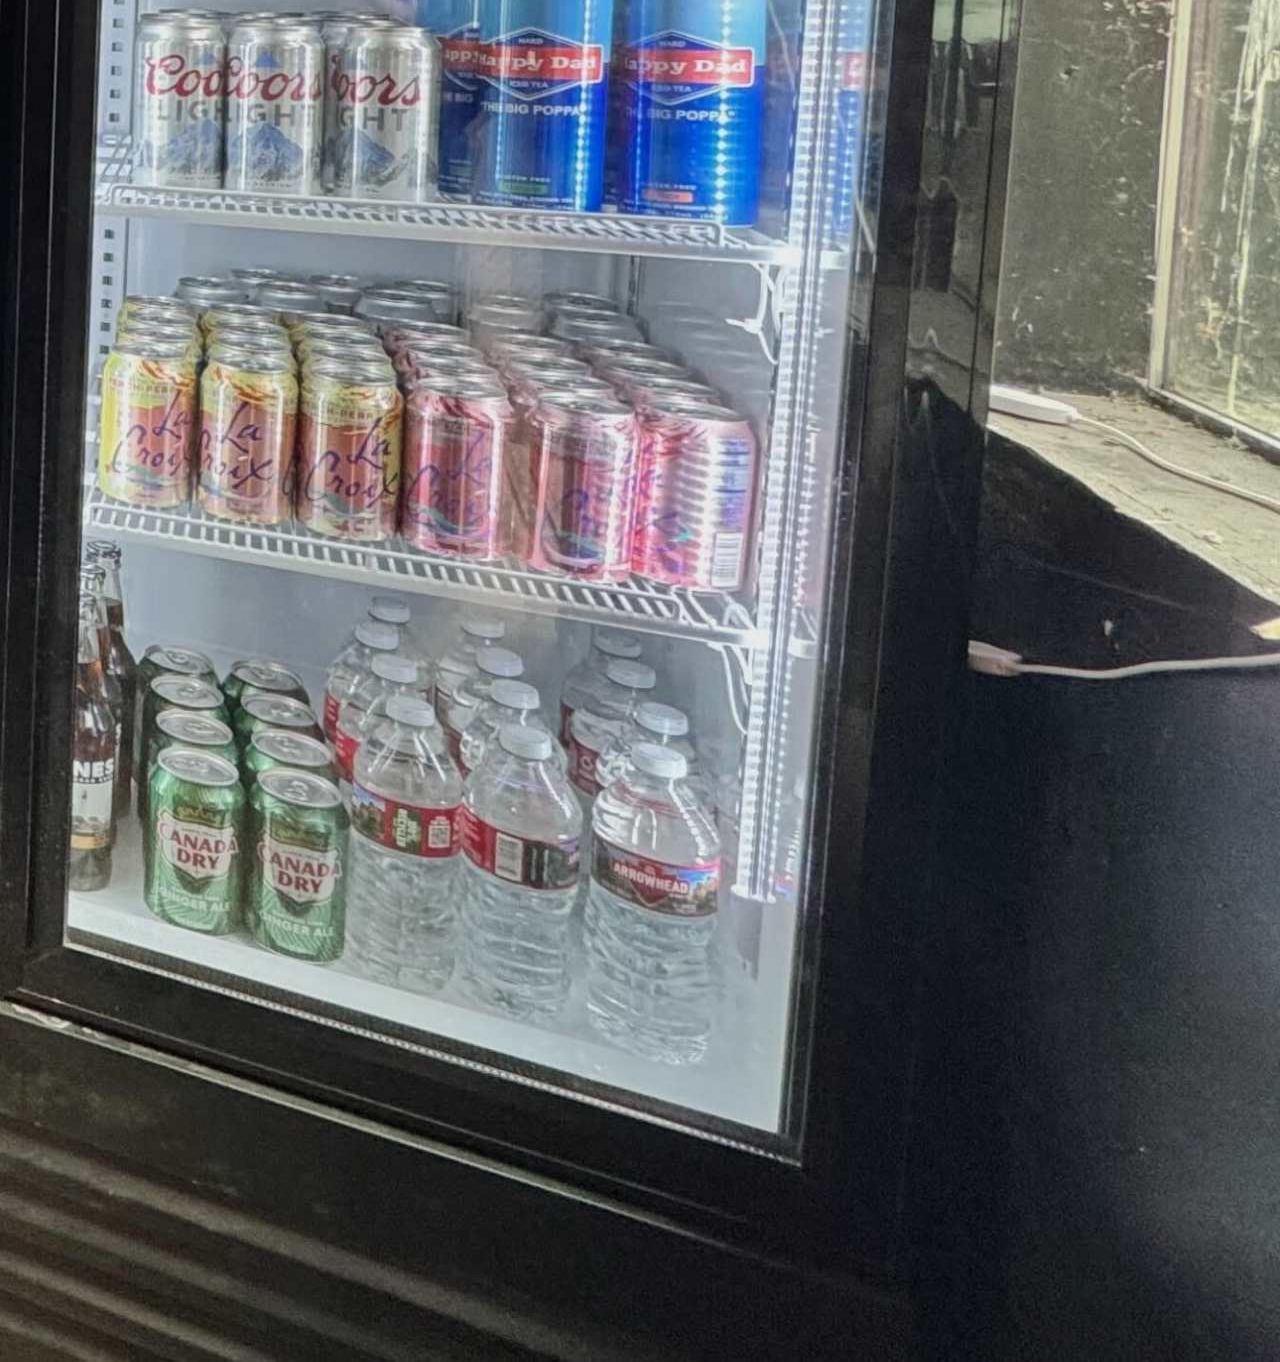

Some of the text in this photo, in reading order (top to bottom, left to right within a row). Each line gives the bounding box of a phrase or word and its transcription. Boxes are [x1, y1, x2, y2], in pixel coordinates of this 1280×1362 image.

[477, 50, 597, 73] Happy Dad
[694, 58, 746, 74] Dad
[507, 103, 529, 115] BIG
[648, 109, 670, 120] BIG
[220, 401, 262, 453] La
[157, 820, 239, 855] CANADA
[176, 846, 222, 871] DRY
[257, 843, 341, 878] CANADA
[277, 871, 323, 896] DRY
[613, 862, 690, 895] ARROWHEAD
[210, 900, 231, 913] ALE
[312, 924, 335, 938] ALE
